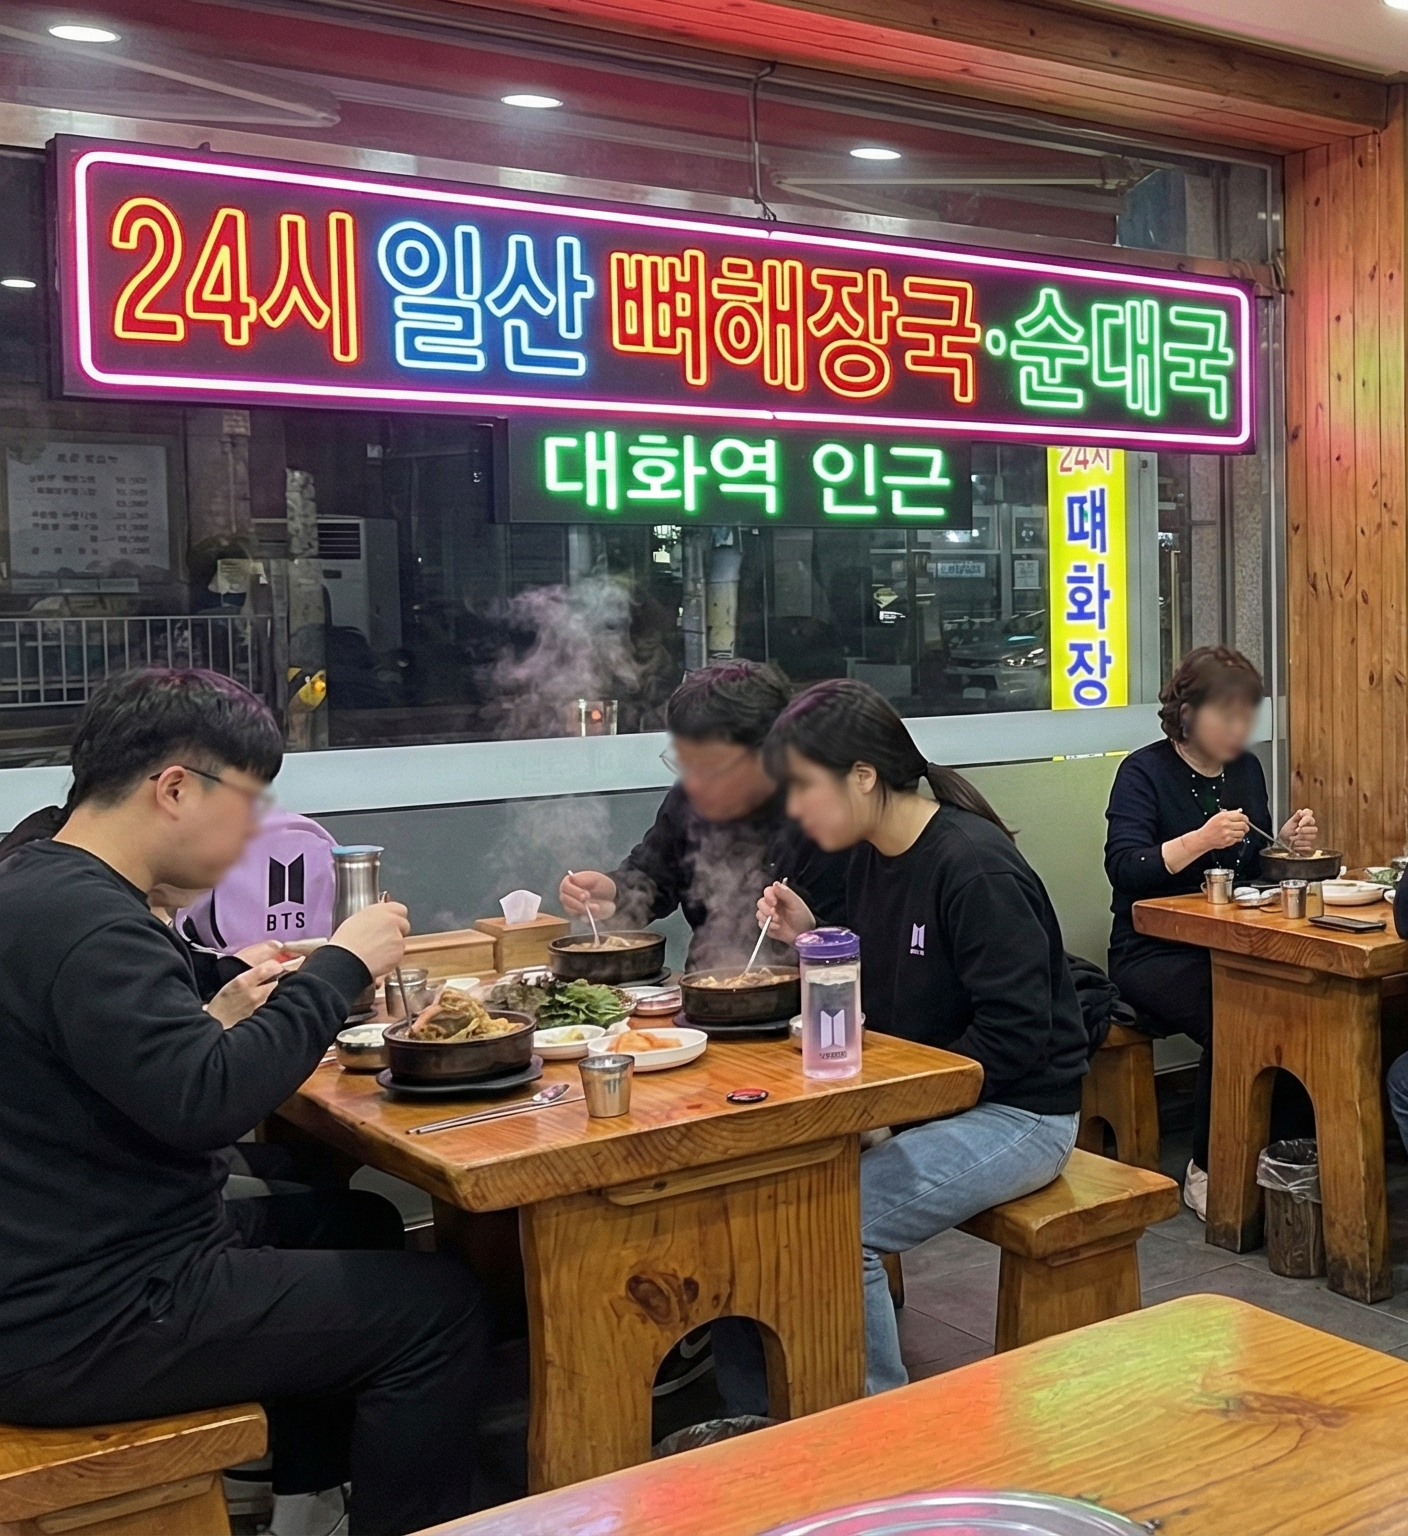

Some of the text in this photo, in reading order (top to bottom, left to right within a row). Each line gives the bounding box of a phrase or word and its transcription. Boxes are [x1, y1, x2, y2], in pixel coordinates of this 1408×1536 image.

[111, 197, 359, 363] 24시
[377, 221, 595, 376] 일산
[544, 430, 952, 517] 대화역 인근
[1060, 447, 1110, 472] 24시
[266, 911, 306, 932] BTS
